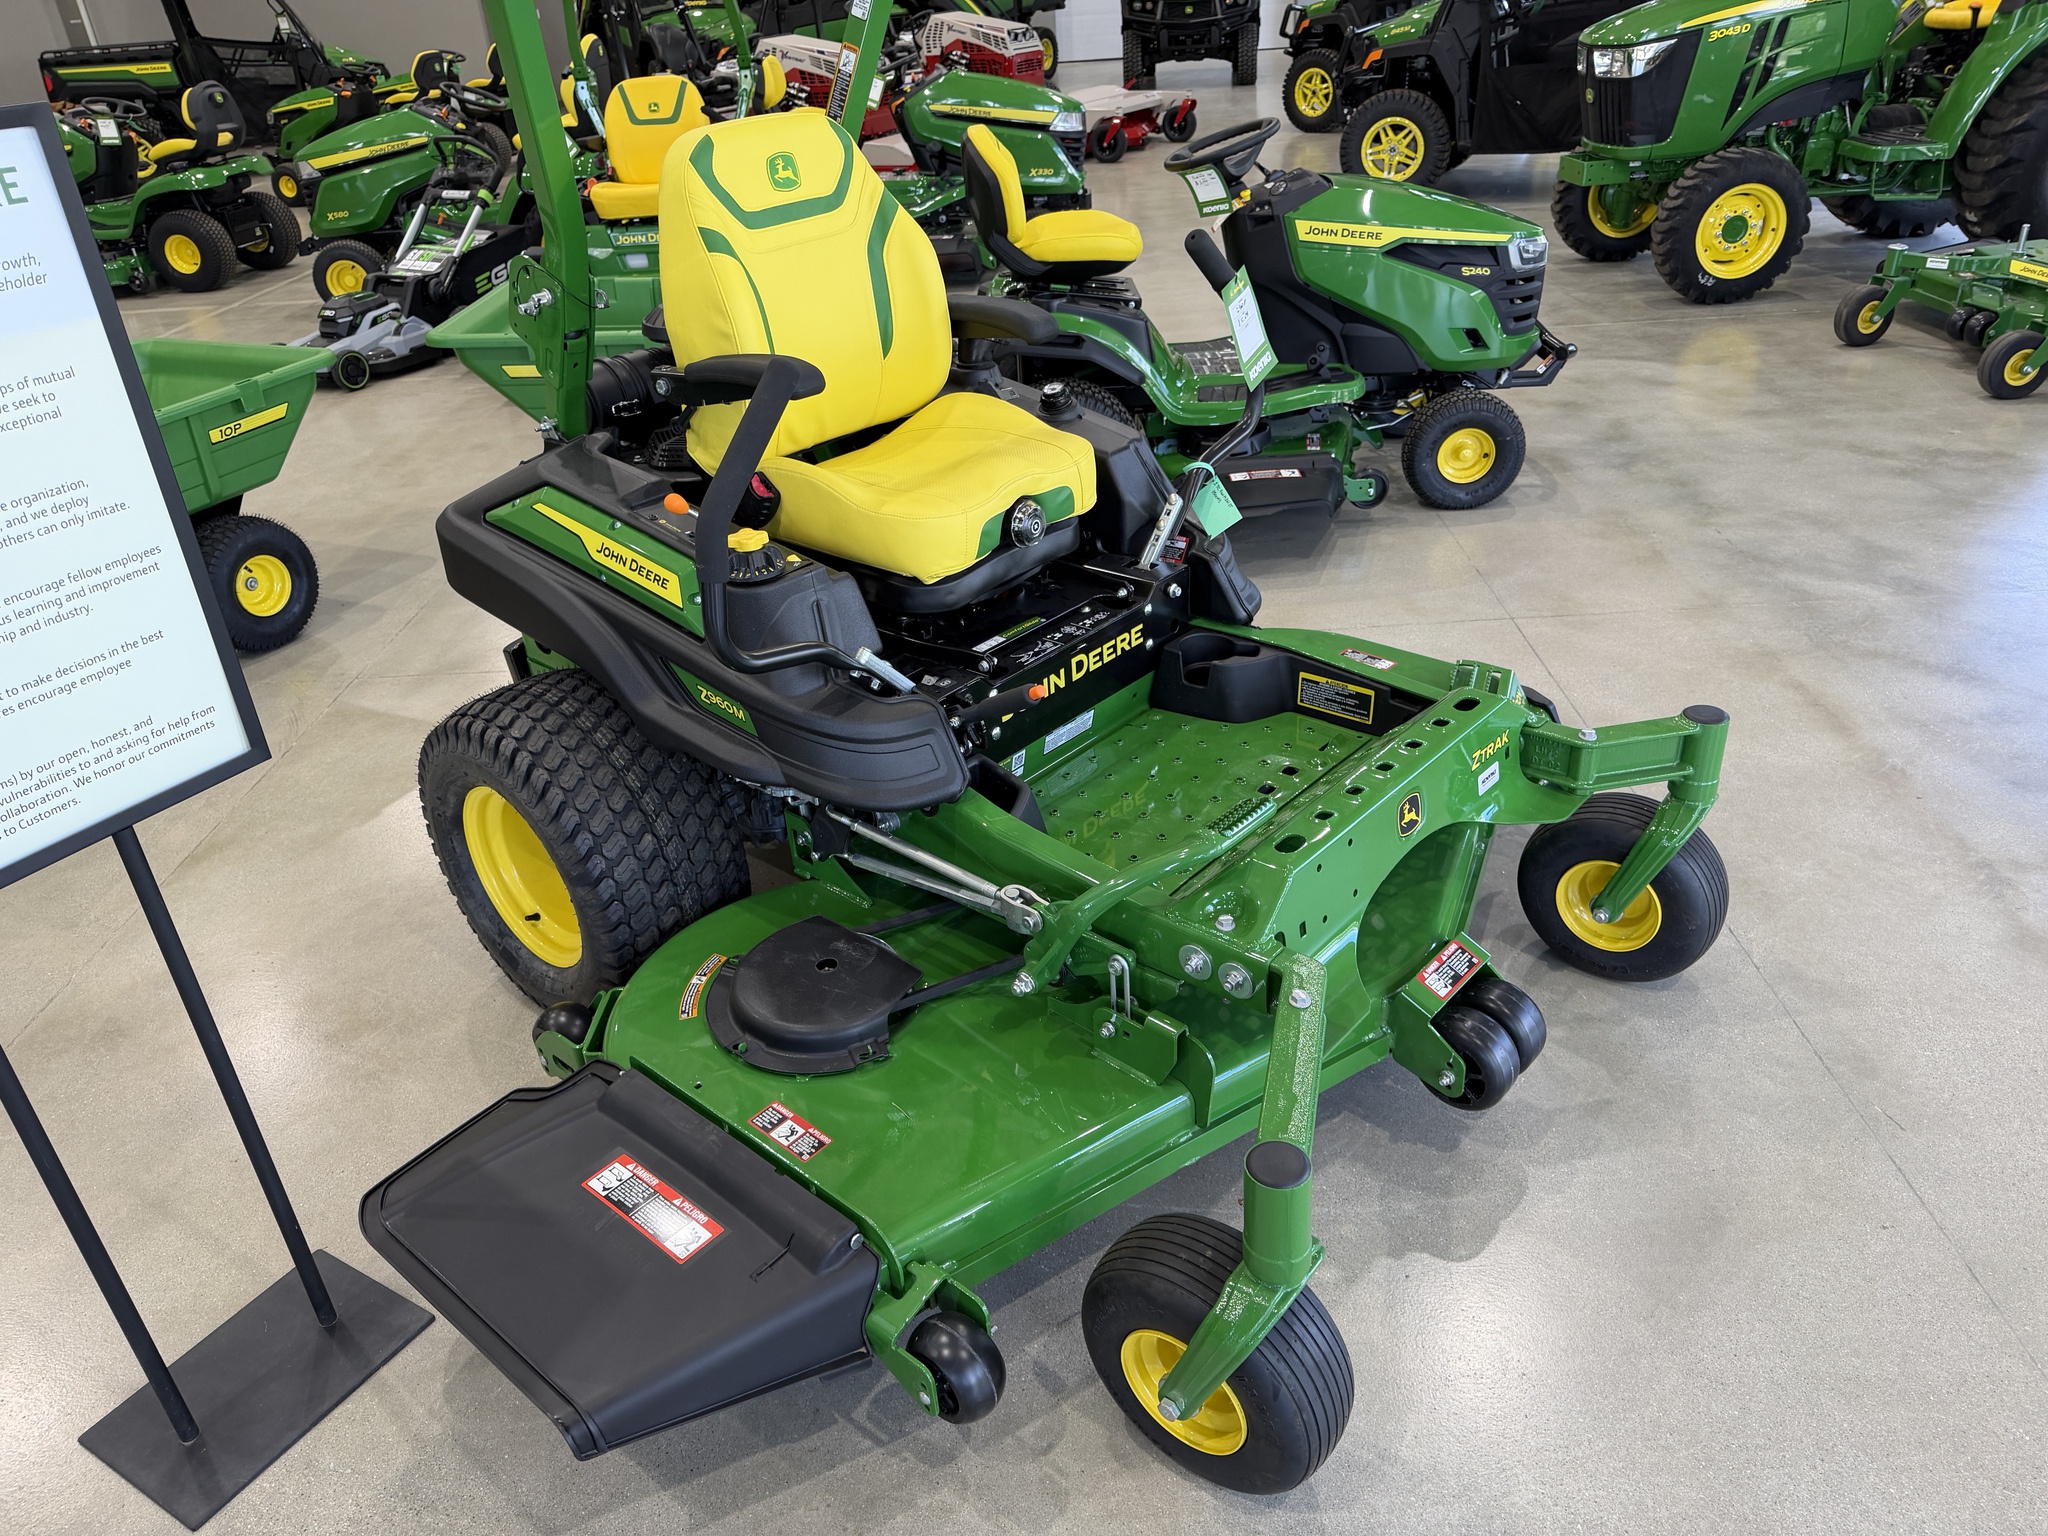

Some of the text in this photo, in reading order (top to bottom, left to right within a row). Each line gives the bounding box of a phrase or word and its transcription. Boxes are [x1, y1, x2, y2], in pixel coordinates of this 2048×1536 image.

[949, 106, 993, 118] JOHN DEERE
[368, 140, 410, 157] JOHN DEERE
[0, 166, 29, 206] E
[1029, 167, 1055, 177] X330
[326, 210, 350, 221] X580
[616, 234, 646, 245] JOHN
[1304, 225, 1383, 241] JOHN DEERE
[0, 252, 41, 271] owth,
[475, 259, 512, 295] EG
[1461, 266, 1491, 277] S240
[2019, 265, 2037, 275] JOHN
[17, 375, 29, 390] of
[32, 365, 76, 387] mutual
[11, 393, 41, 411] seek
[42, 392, 56, 403] to
[219, 422, 241, 439] 10P
[10, 480, 89, 508] organization,
[0, 502, 131, 550] others can only imitate.
[5, 496, 89, 529] and we deploy
[3, 545, 162, 607] encourage fellow employees
[596, 542, 670, 591] JOHN DEERE
[13, 597, 64, 620] learning
[65, 586, 87, 603] and
[88, 561, 161, 594] improvement
[19, 620, 42, 637] and
[43, 604, 94, 629] industry.
[5, 629, 164, 698] to make decisions in the best
[1071, 622, 1144, 682] DEERE
[0, 658, 133, 719] es encourage employee
[697, 685, 746, 722] Z960M
[0, 705, 216, 807] vulnerabilities to and asking for help from
[19, 769, 33, 782] by
[36, 759, 56, 774] our
[58, 746, 90, 765] open,
[90, 727, 132, 750] honest,
[133, 715, 154, 732] and
[72, 774, 93, 789] We
[93, 759, 126, 780] honor
[128, 750, 146, 765] our
[148, 719, 216, 756] commitments
[1471, 728, 1510, 772] ZTRAK
[3, 796, 82, 837] to Customers.
[776, 1103, 795, 1119] DANGER
[812, 1128, 832, 1145] PELIGRO
[634, 1166, 660, 1187] DANGER
[680, 1201, 709, 1225] PELIGRO
